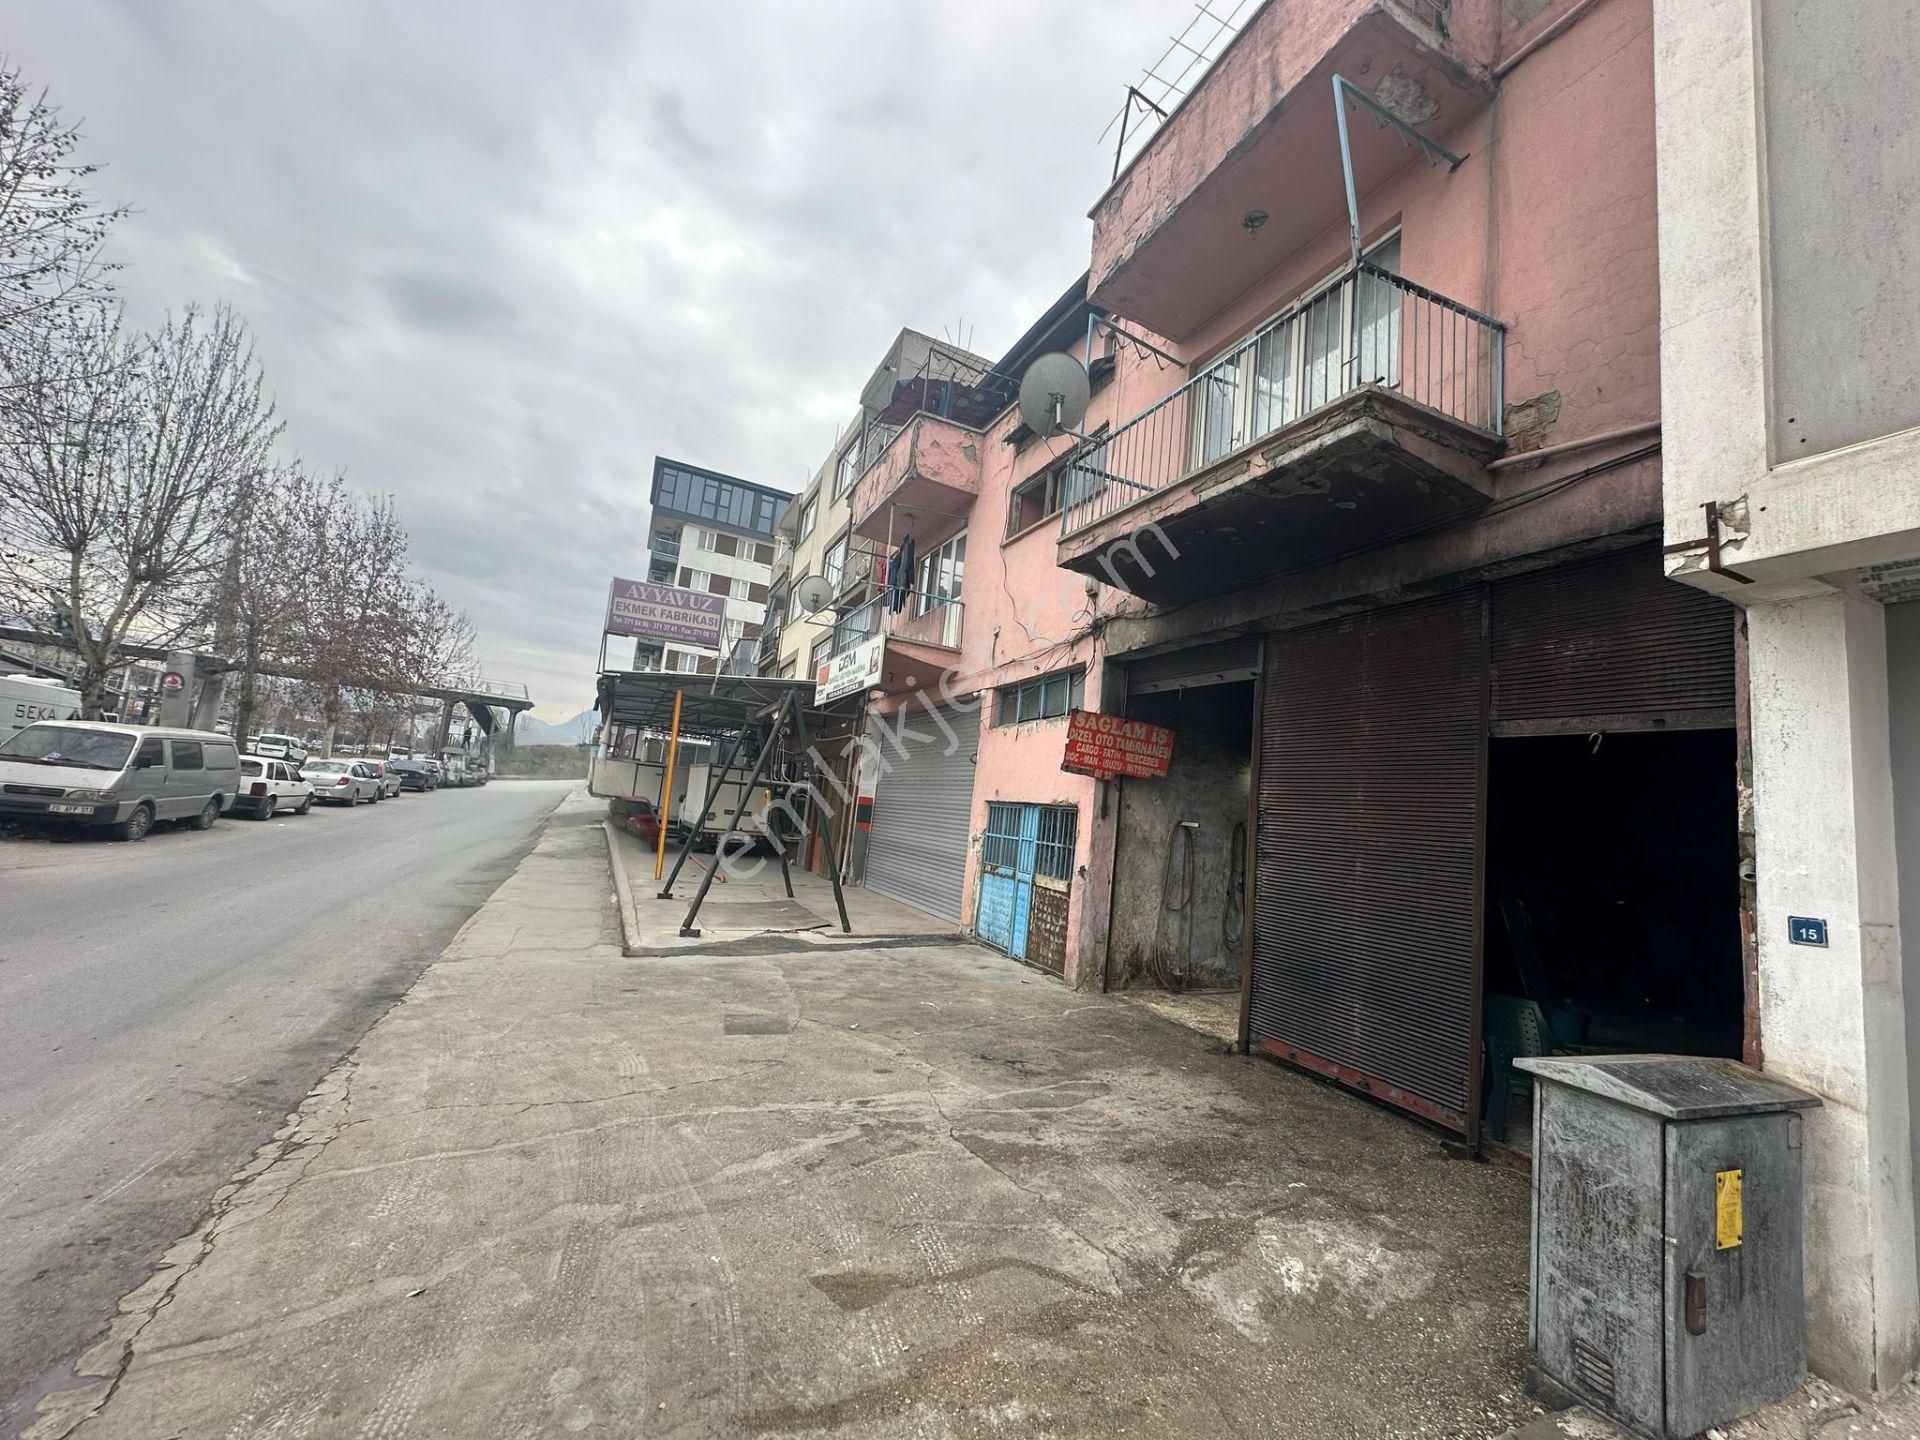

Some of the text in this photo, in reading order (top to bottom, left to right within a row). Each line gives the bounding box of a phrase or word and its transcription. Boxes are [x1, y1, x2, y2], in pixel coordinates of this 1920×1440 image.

[625, 584, 714, 611] AYYAVUZ
[615, 600, 657, 617] EKMEK
[15, 704, 56, 720] SEKA
[1095, 732, 1114, 747] OTO
[1076, 743, 1099, 755] CARGO
[1083, 755, 1099, 766] MAN
[1799, 928, 1818, 940] 15
